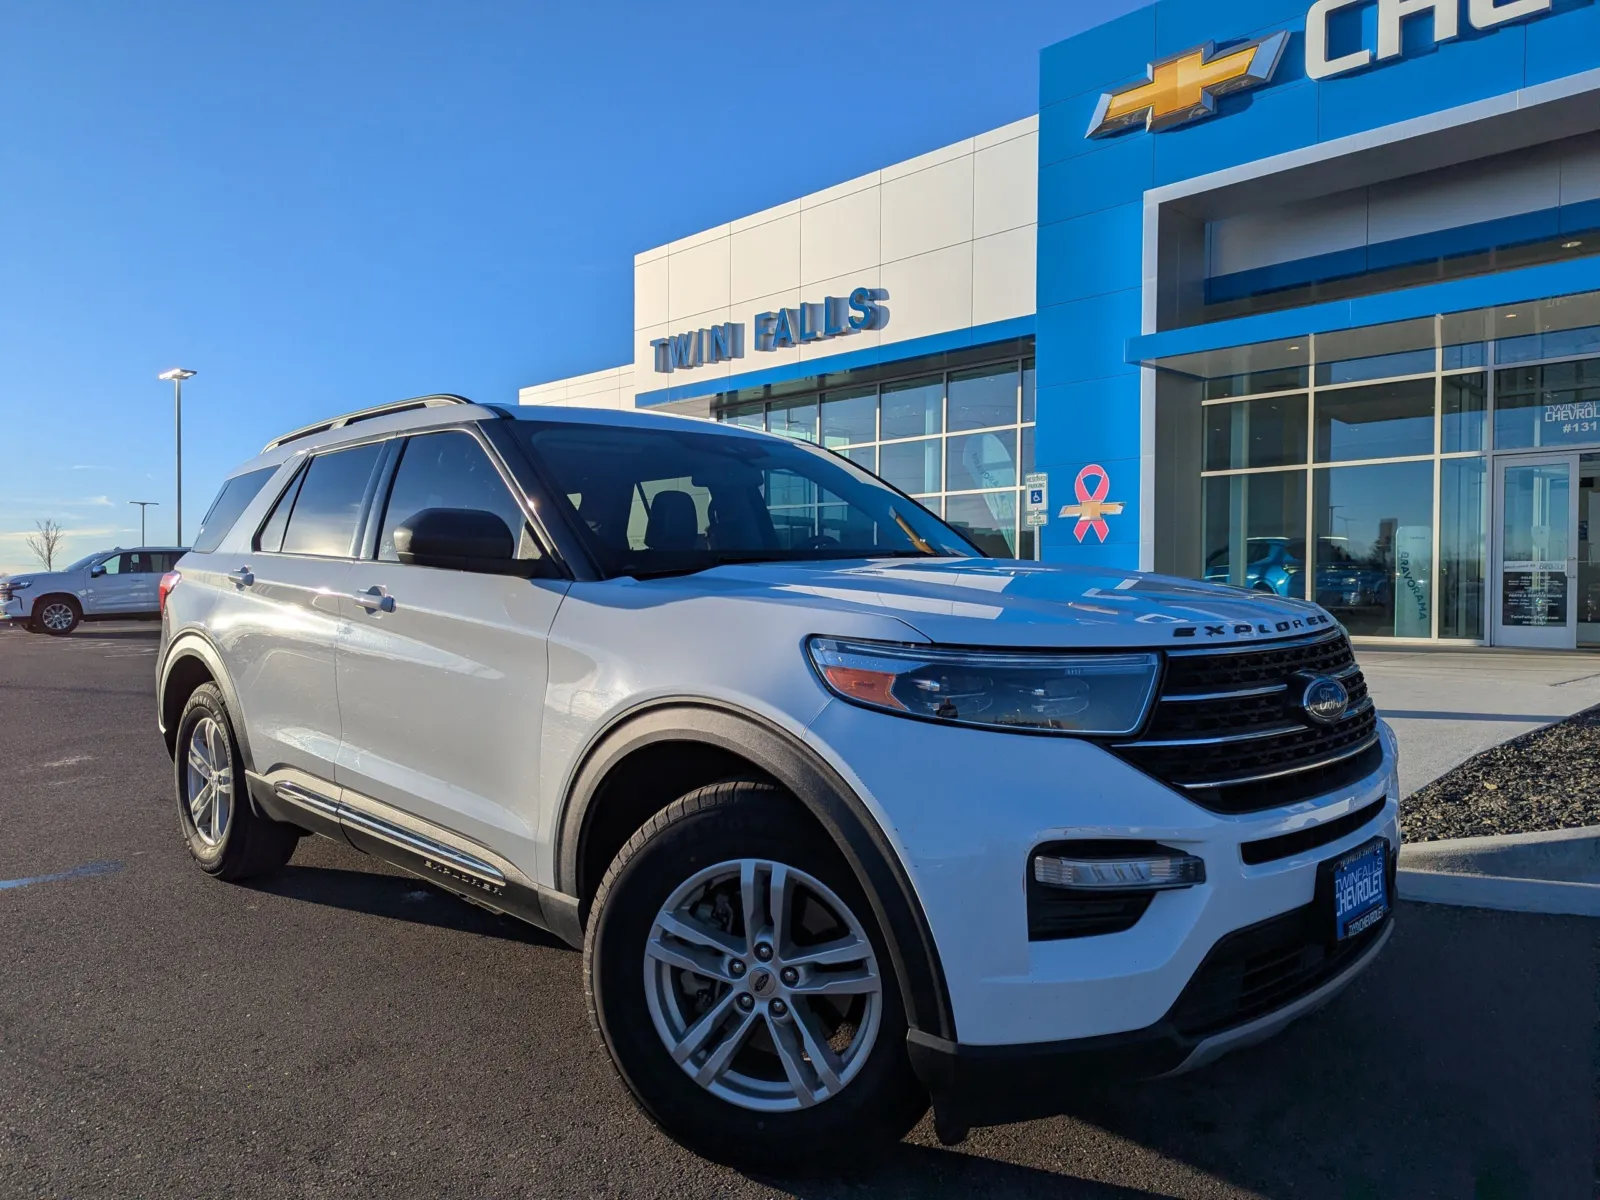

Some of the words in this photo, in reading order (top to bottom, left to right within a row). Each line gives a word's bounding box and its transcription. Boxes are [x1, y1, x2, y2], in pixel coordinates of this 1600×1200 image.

[650, 322, 731, 373] TWIN
[754, 287, 873, 352] FALLS
[1400, 551, 1428, 620] BRAVORAMA
[1172, 614, 1329, 638] EXPLORER
[1320, 687, 1342, 712] Ford
